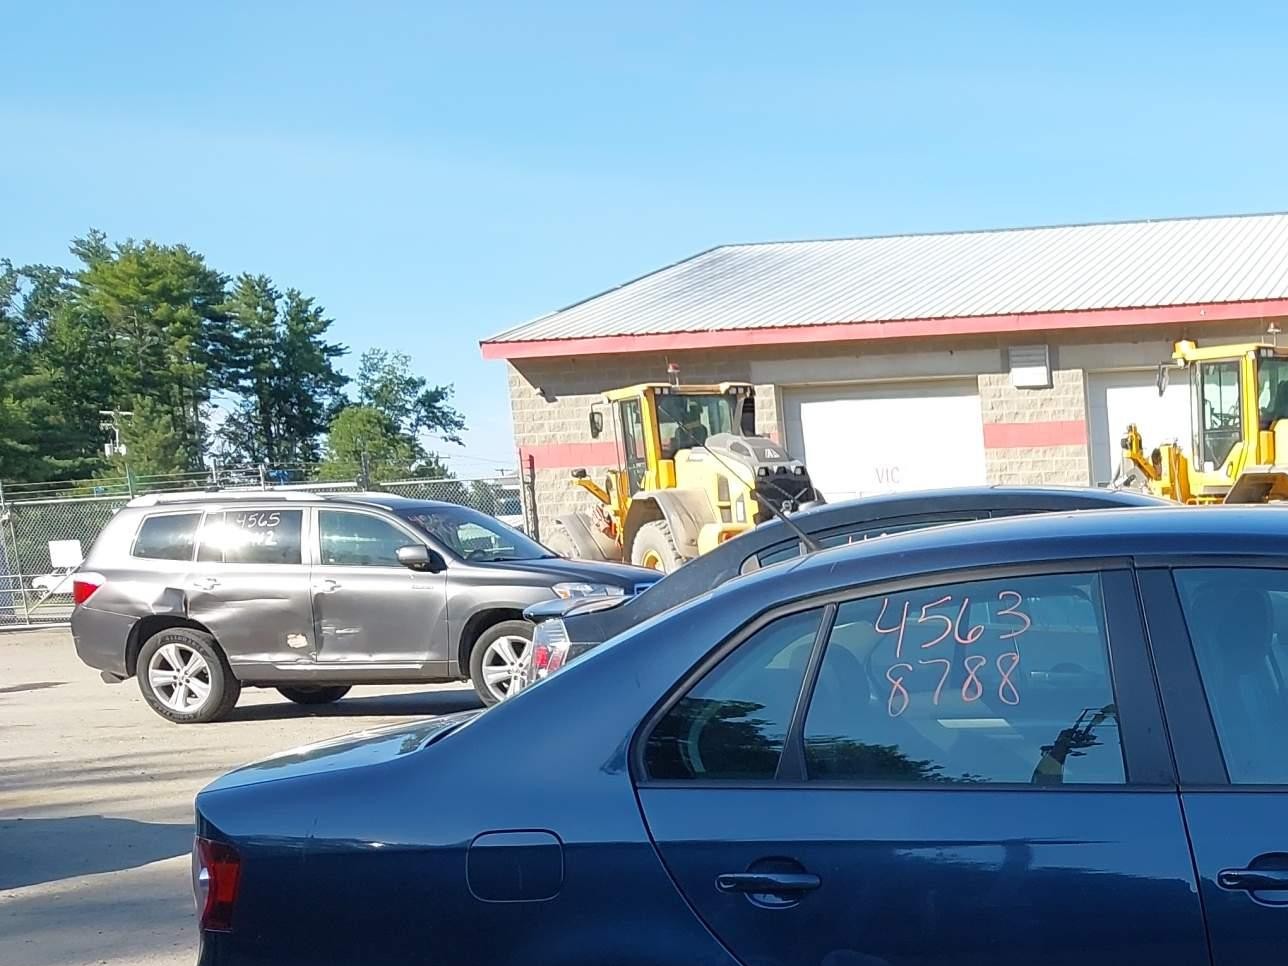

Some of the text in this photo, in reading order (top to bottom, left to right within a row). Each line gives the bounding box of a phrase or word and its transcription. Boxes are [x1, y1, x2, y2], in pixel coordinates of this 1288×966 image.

[236, 512, 281, 529] 4565
[875, 590, 1032, 658] 4563
[886, 652, 1021, 717] 8788
